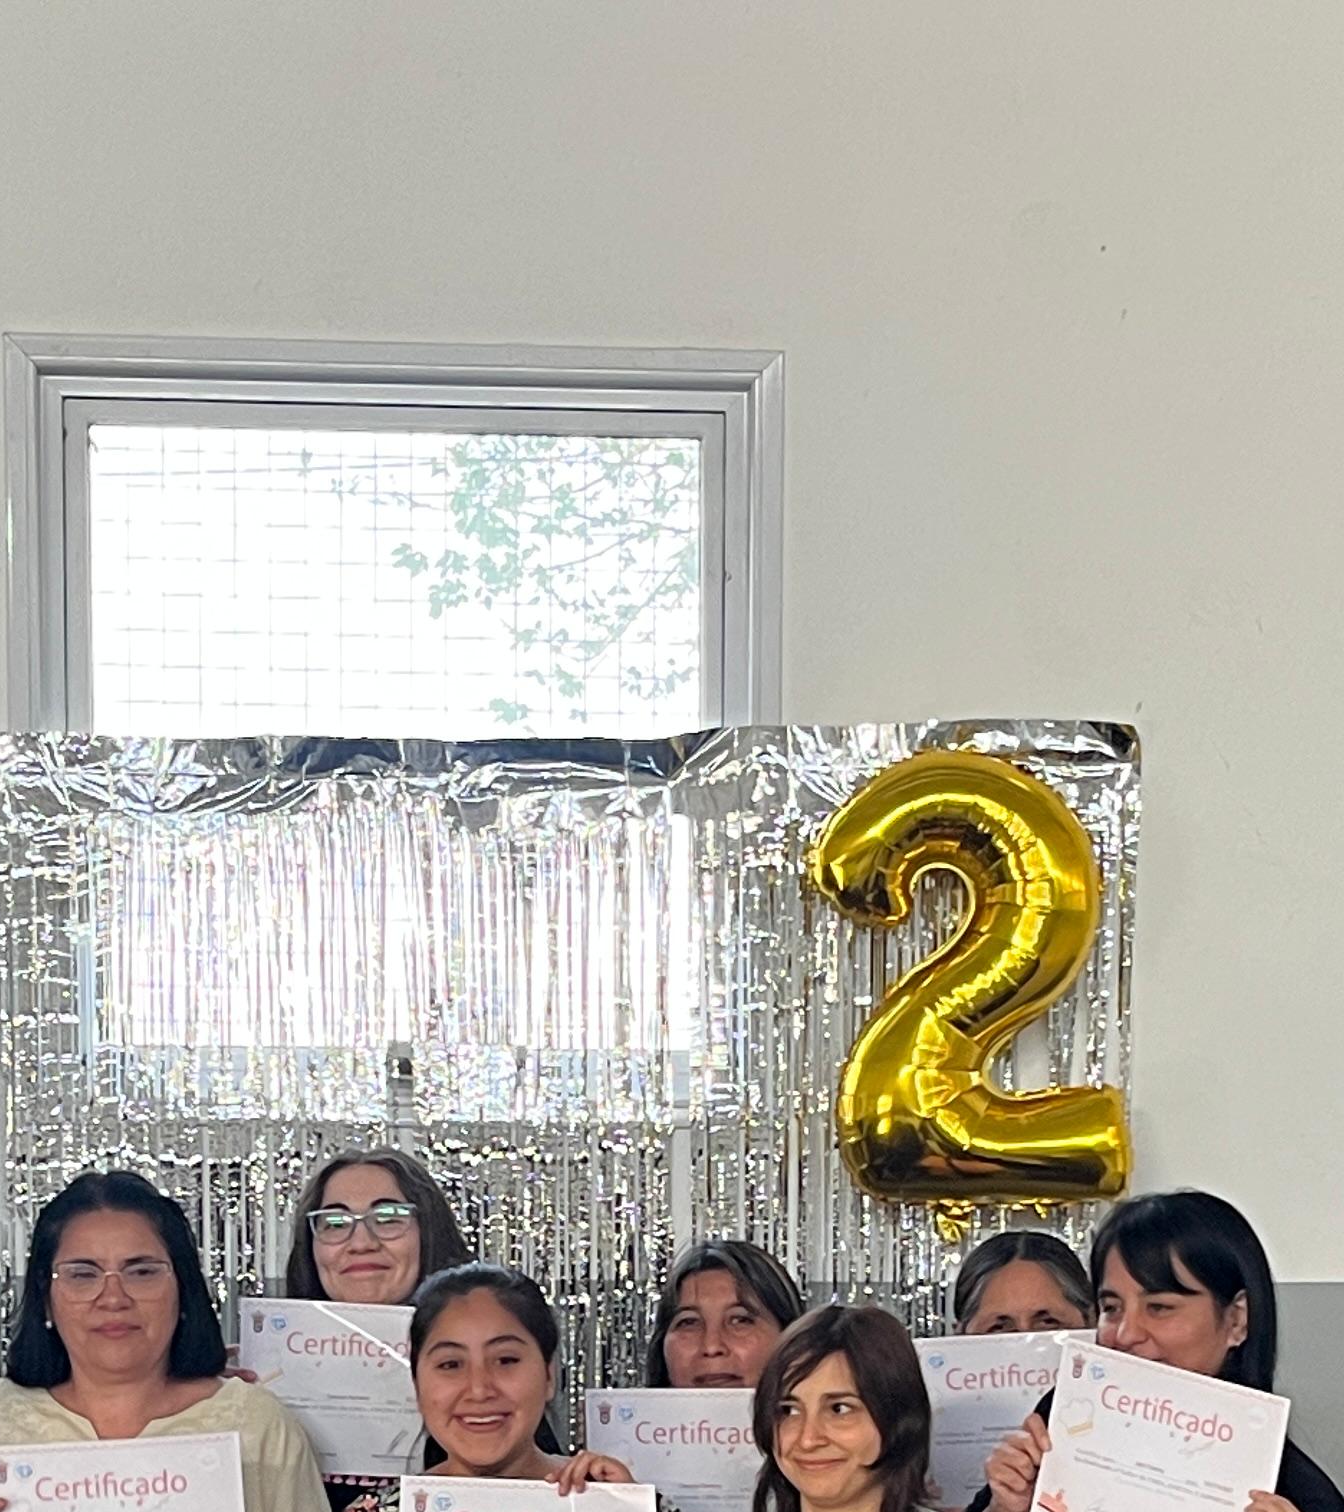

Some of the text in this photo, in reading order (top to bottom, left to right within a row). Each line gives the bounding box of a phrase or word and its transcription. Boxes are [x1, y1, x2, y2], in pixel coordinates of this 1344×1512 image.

[810, 750, 1133, 1204] 2
[287, 1330, 411, 1358] Certificad
[946, 1363, 1058, 1391] Certifica
[1101, 1385, 1234, 1442] Certificado
[35, 1469, 188, 1501] Certificado
